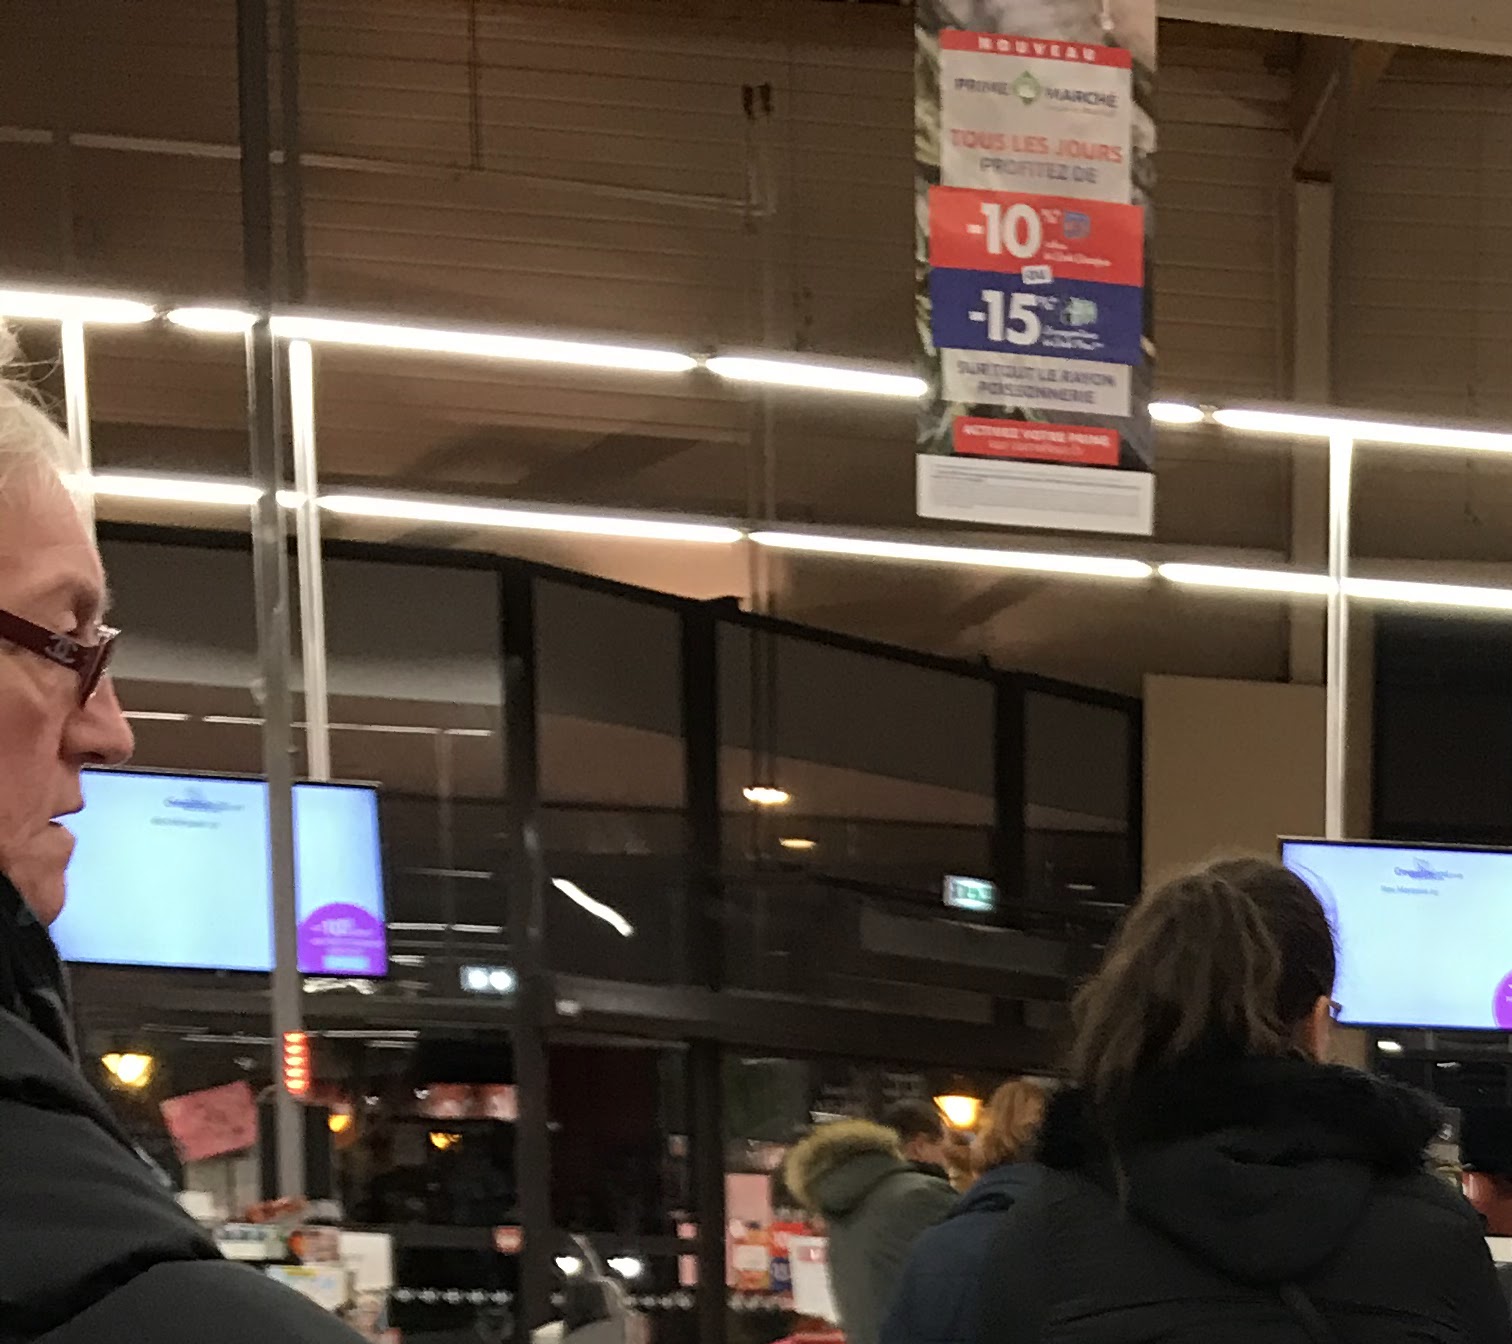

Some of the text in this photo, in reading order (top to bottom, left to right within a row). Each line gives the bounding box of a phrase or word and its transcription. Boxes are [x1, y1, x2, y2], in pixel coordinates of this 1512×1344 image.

[951, 128, 1122, 163] TOUS LES JOURS
